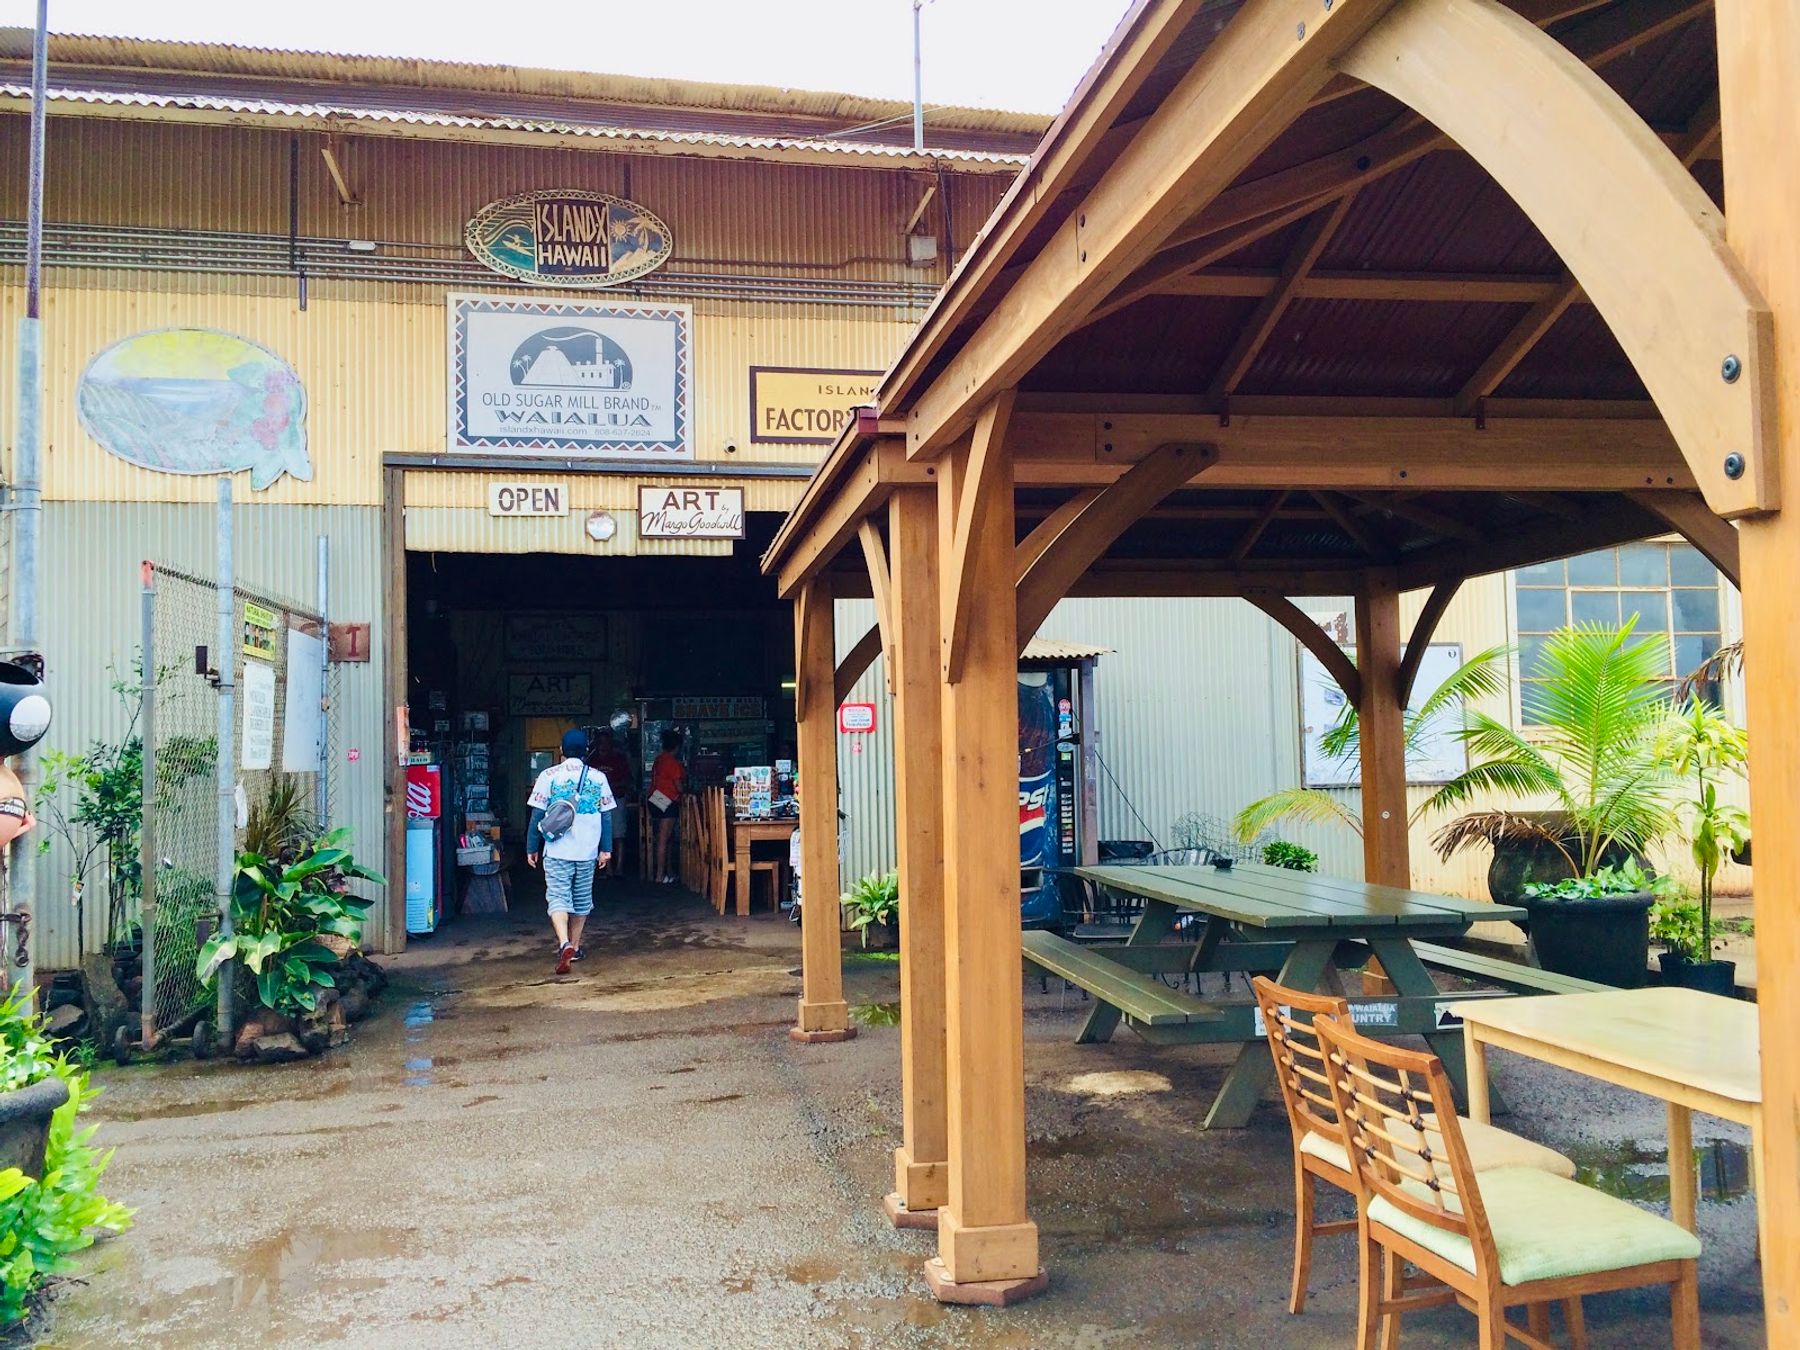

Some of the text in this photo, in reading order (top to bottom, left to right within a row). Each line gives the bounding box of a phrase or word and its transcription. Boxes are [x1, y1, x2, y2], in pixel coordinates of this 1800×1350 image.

[538, 244, 607, 267] HAWAII
[818, 385, 872, 396] ISLAN
[482, 392, 511, 407] OLD
[516, 393, 562, 408] SUGAR
[567, 395, 599, 410] MILL
[604, 396, 649, 411] BRAND
[495, 409, 653, 427] WAIALUA
[766, 407, 851, 432] FACTOR
[499, 425, 587, 436] islandxhawaii.com
[498, 487, 560, 512] OPEN
[662, 491, 720, 511] ART
[642, 511, 743, 534] Margo Goodwill
[527, 675, 576, 693] ART
[1351, 1013, 1392, 1023] UNTRY
